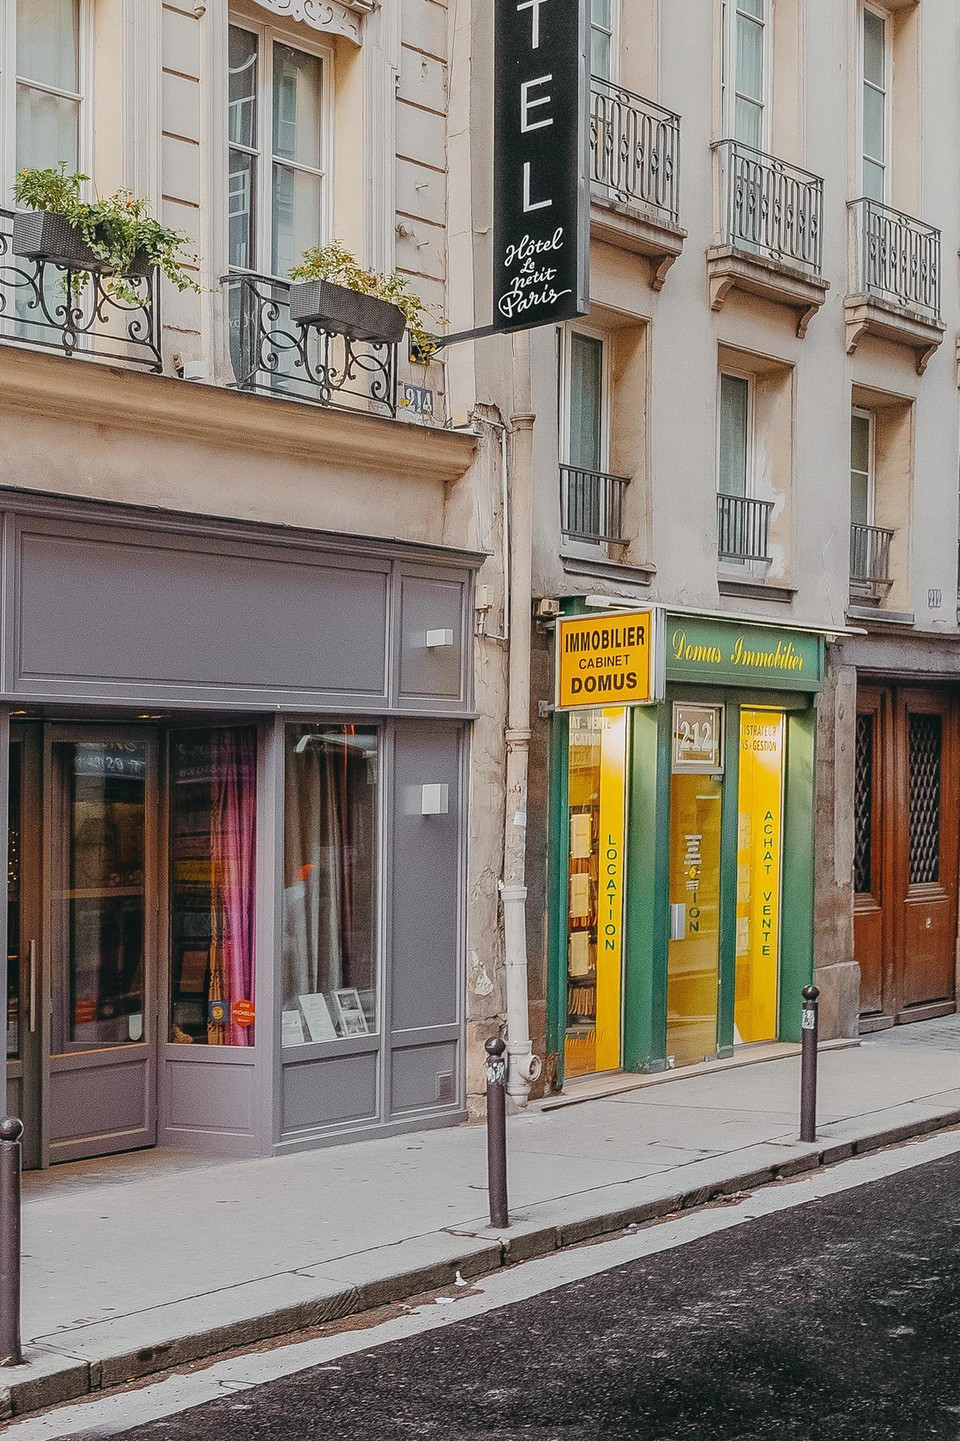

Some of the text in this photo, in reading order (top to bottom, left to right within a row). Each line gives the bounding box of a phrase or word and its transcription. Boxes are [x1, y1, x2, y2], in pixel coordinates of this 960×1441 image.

[504, 227, 564, 267] Hôtel
[520, 257, 535, 273] Le
[510, 266, 558, 298] petit
[498, 284, 572, 318] Paris
[565, 626, 645, 653] IMMOBILIER
[672, 628, 804, 670] Domus Immobilier
[578, 654, 631, 670] CABINET
[571, 672, 637, 694] DOMUS
[680, 721, 713, 751] 212
[605, 834, 618, 951] LOCATION
[762, 811, 773, 956] ACHAT VENTE
